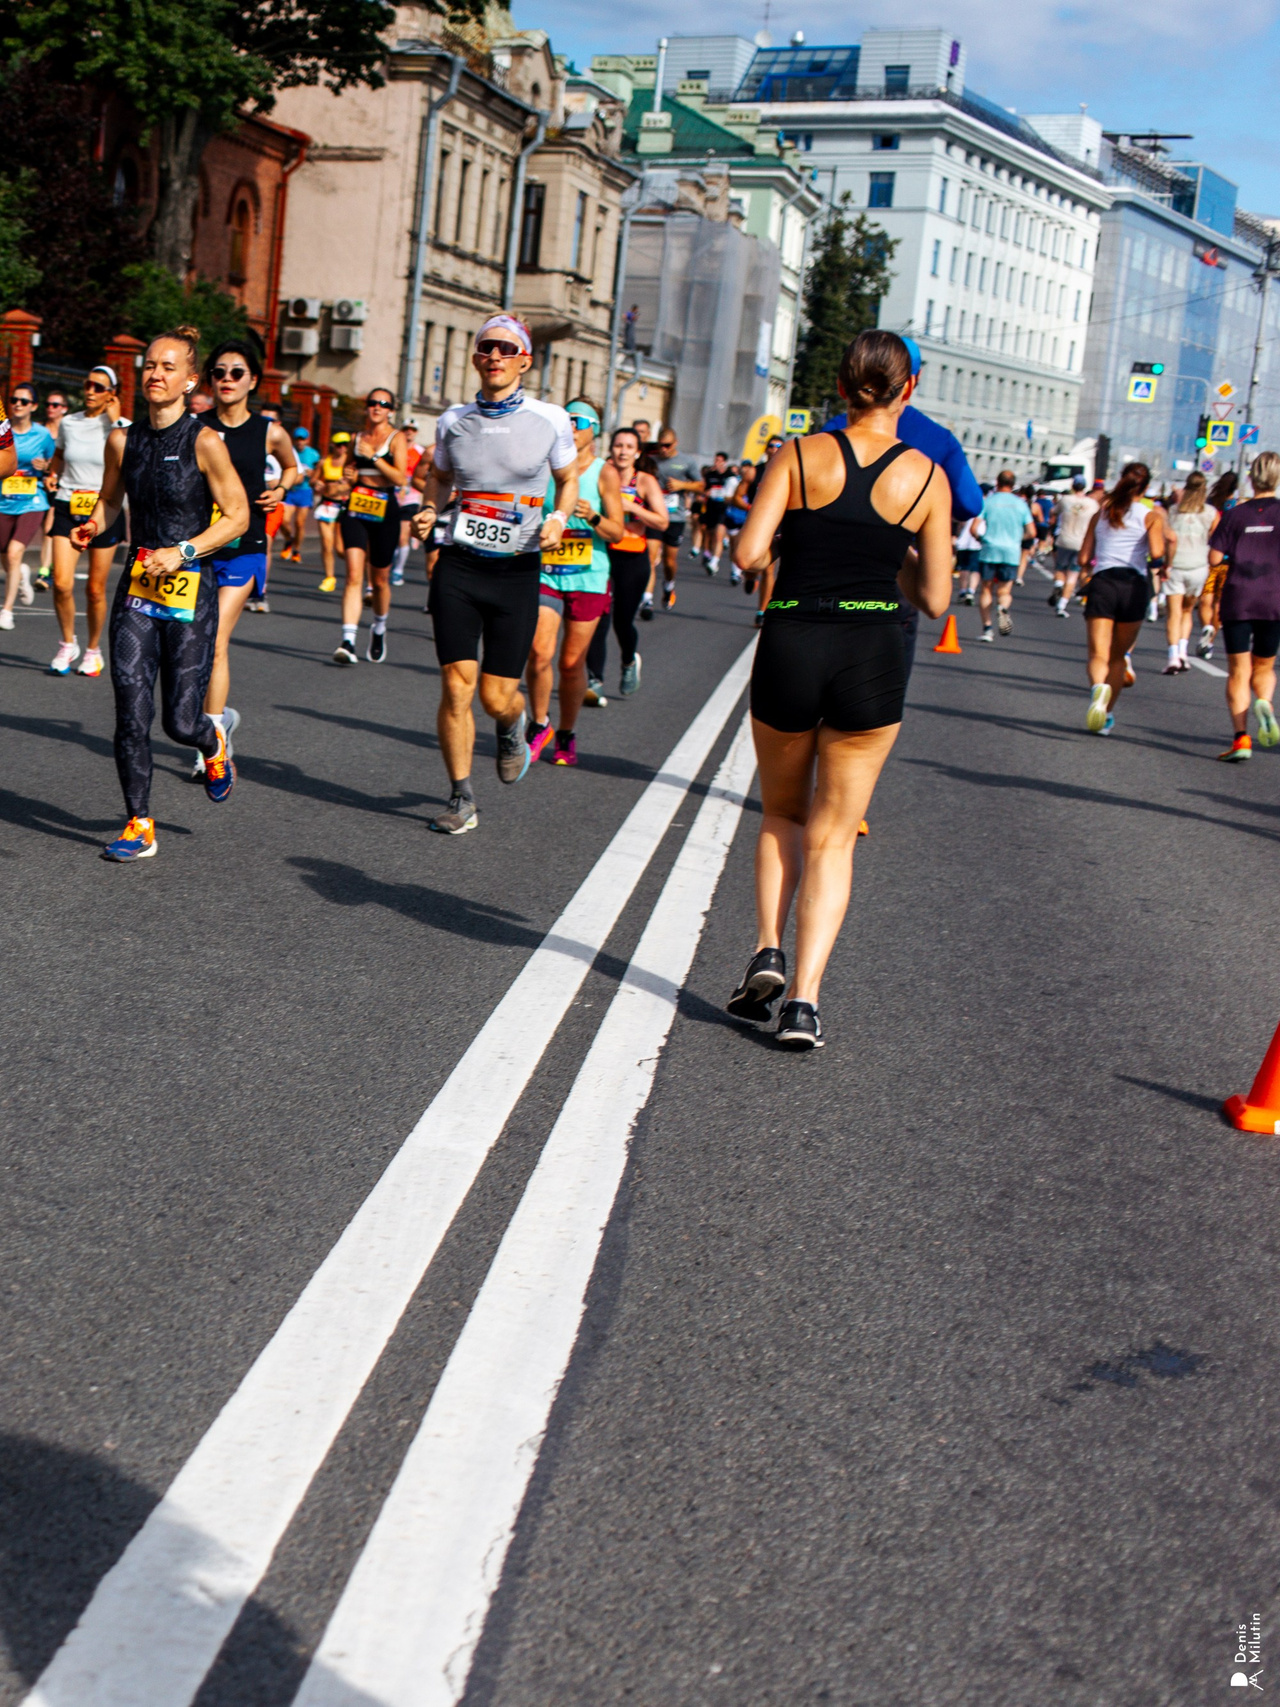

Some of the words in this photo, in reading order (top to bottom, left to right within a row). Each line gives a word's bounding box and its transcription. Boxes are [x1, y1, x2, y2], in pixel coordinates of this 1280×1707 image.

[354, 497, 382, 511] 2217
[465, 519, 511, 544] 5835
[139, 569, 189, 597] 6152
[131, 597, 142, 609] D
[838, 600, 899, 612] POWERUP
